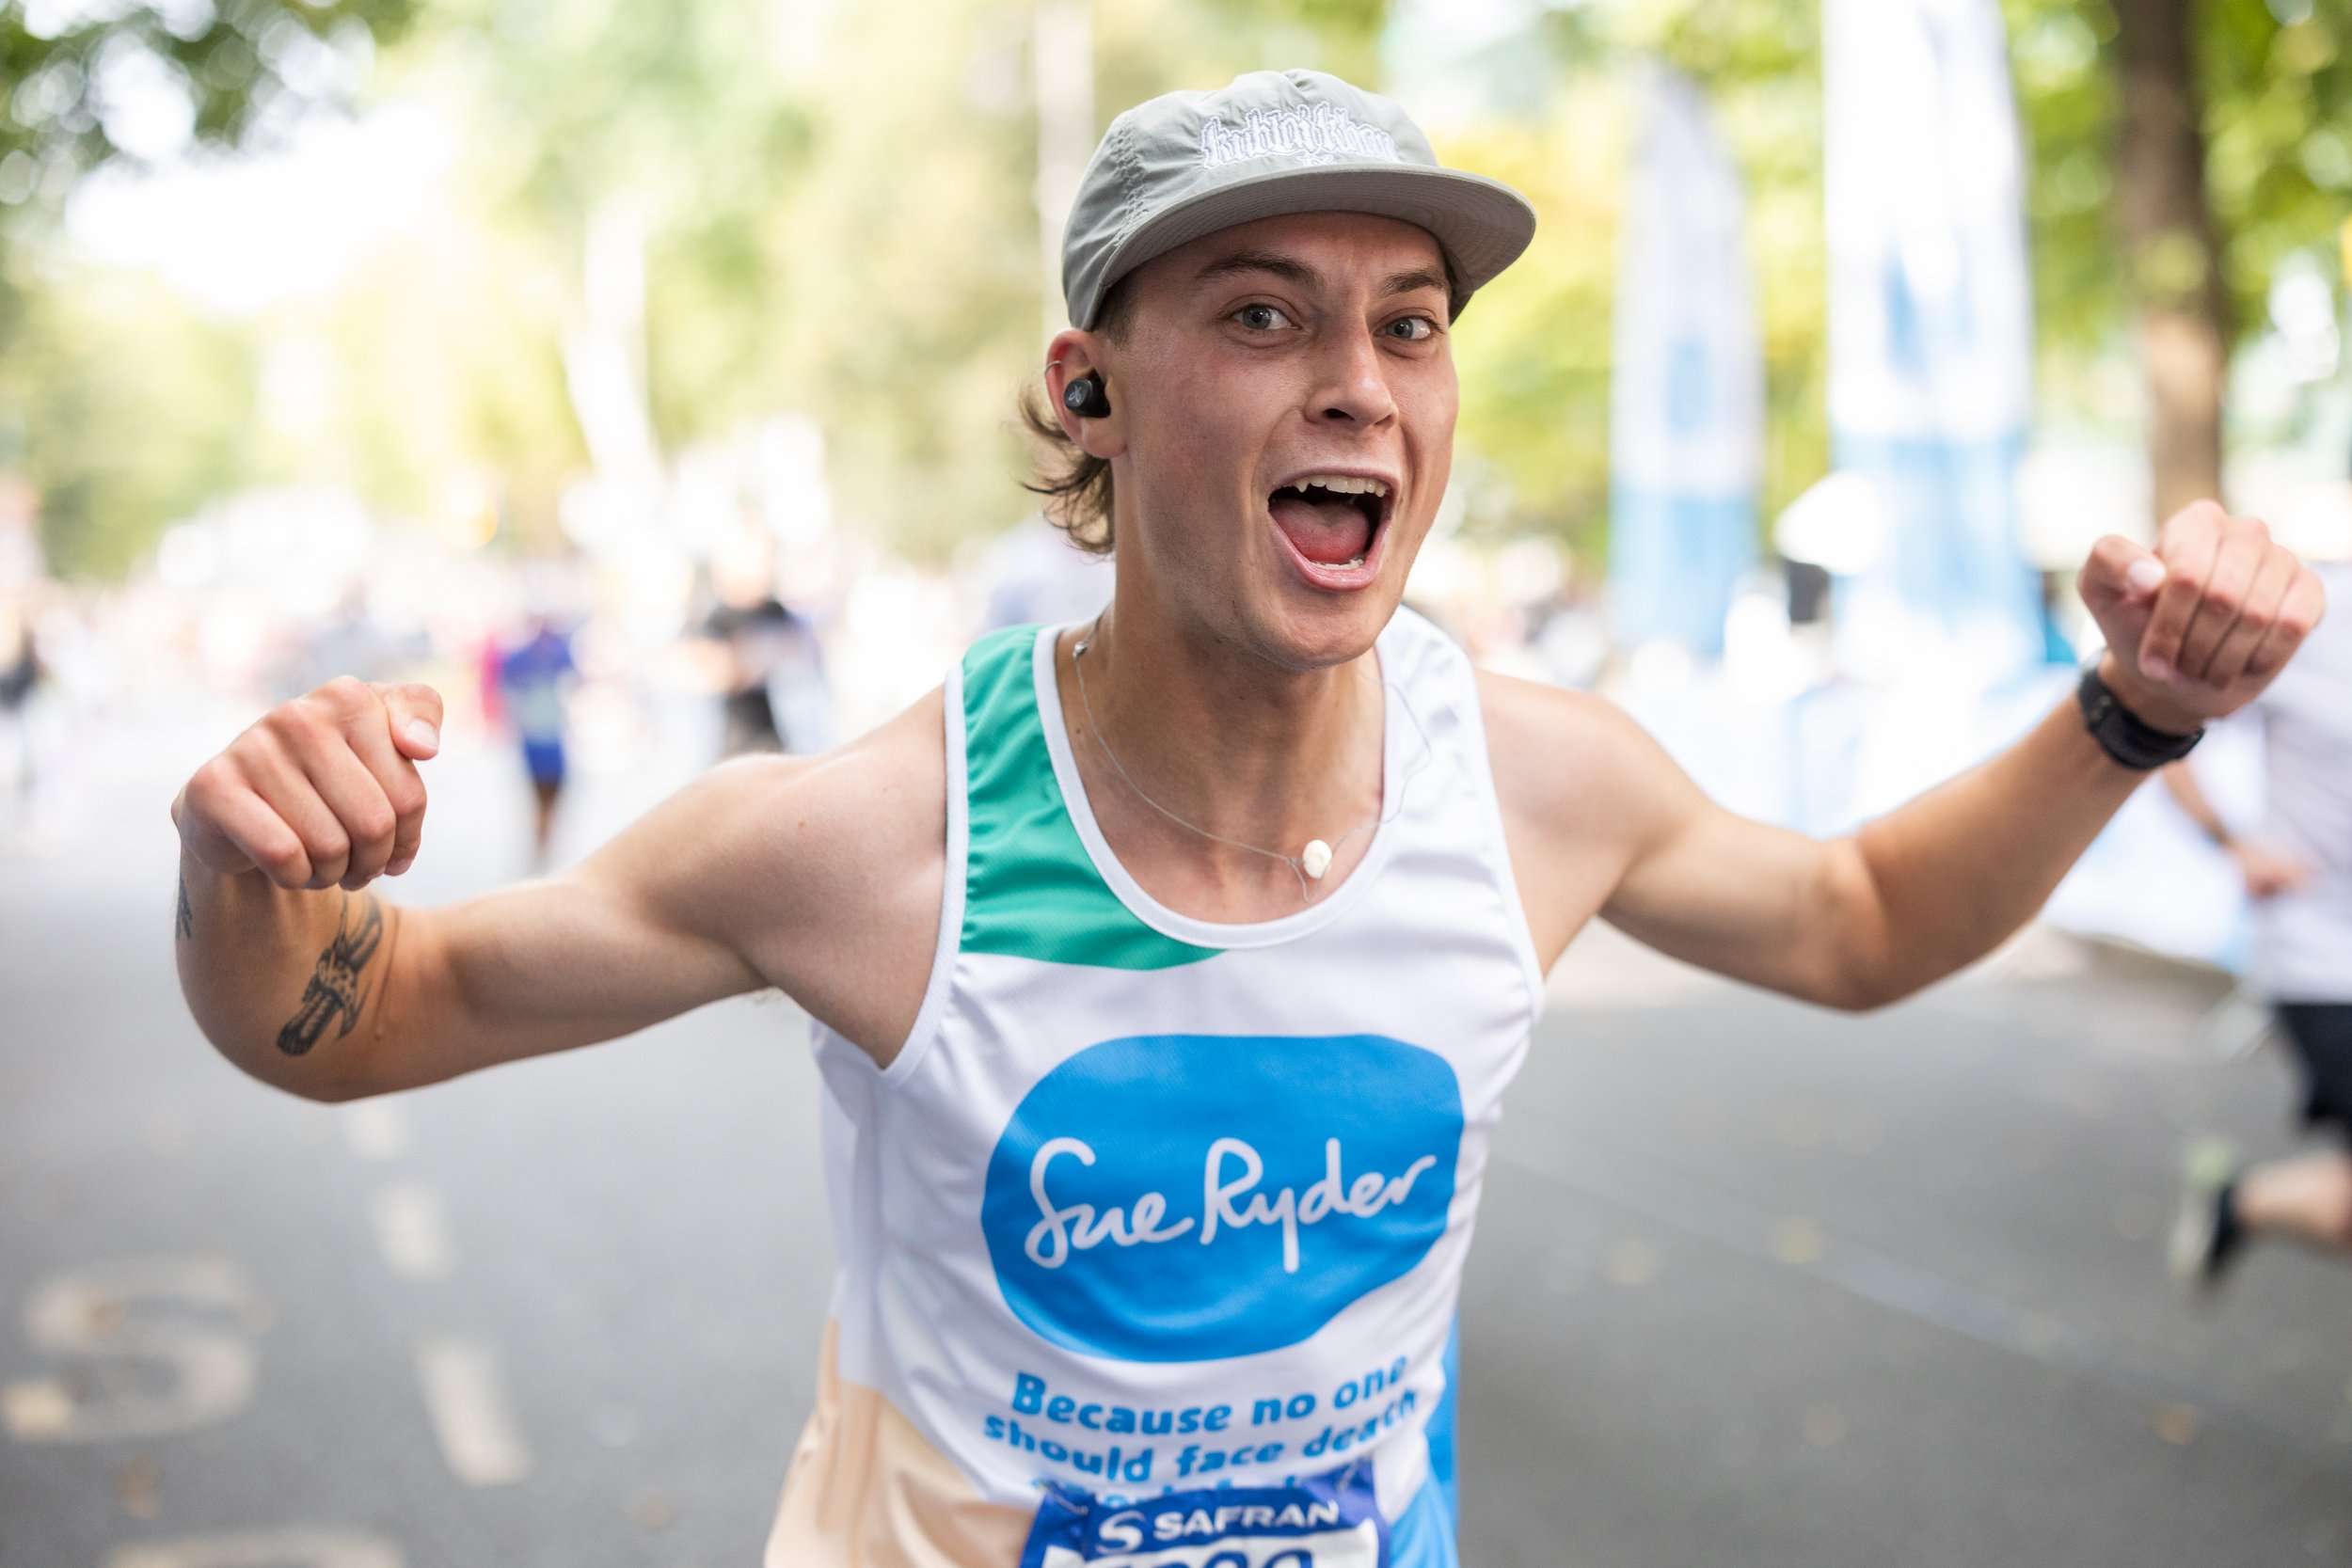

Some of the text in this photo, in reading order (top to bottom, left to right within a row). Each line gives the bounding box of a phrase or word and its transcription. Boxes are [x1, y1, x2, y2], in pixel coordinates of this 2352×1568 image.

[1025, 1137, 1437, 1273] Sue Ryder
[984, 1389, 1415, 1482] should face death
[1011, 1356, 1406, 1435] Because no one
[1153, 1499, 1340, 1542] SAFRAN
